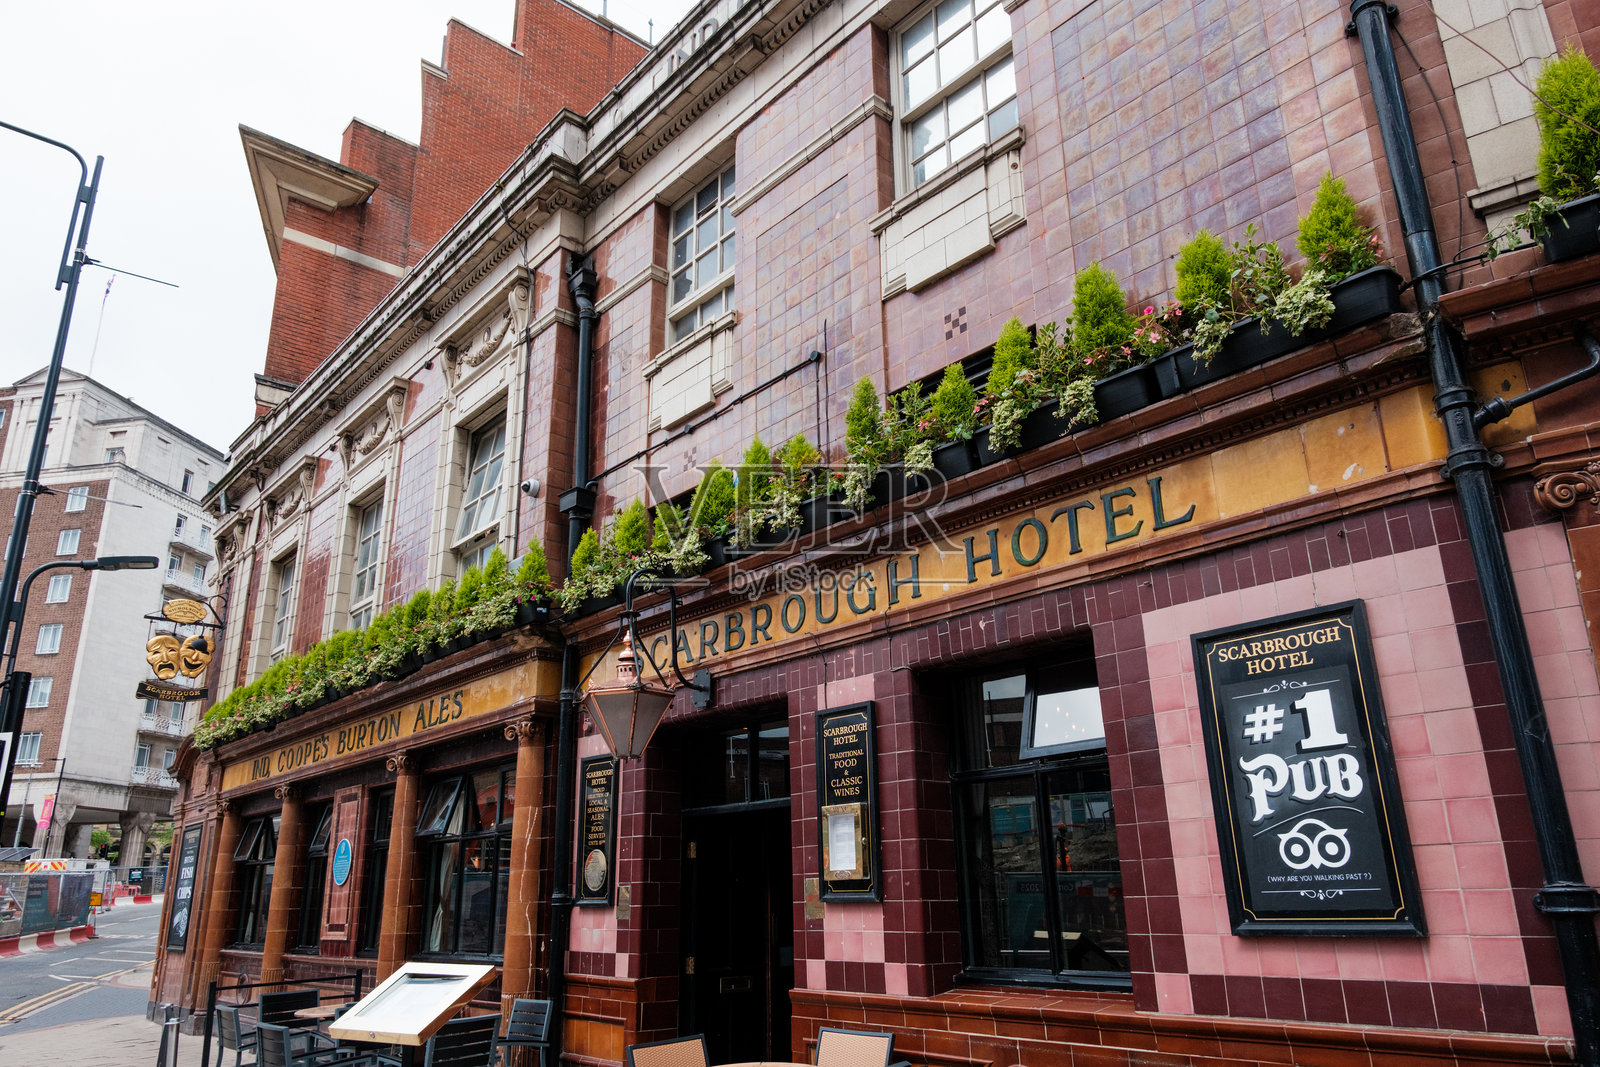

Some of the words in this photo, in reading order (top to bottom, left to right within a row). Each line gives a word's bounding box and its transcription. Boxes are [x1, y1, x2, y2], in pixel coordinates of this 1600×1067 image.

[963, 475, 1196, 585] HOTEL
[1218, 626, 1342, 663] SCARBROUGH
[1246, 651, 1314, 675] HOTEL
[337, 711, 401, 754] BURTON
[412, 690, 464, 733] ALES
[824, 723, 867, 737] SCARBROUGH
[833, 735, 858, 745] HOTEL
[829, 749, 864, 759] TRADITIONAL
[834, 759, 857, 769] FOOD
[831, 776, 862, 787] CLASSIC
[834, 787, 859, 796] WINES
[180, 867, 194, 879] FISH
